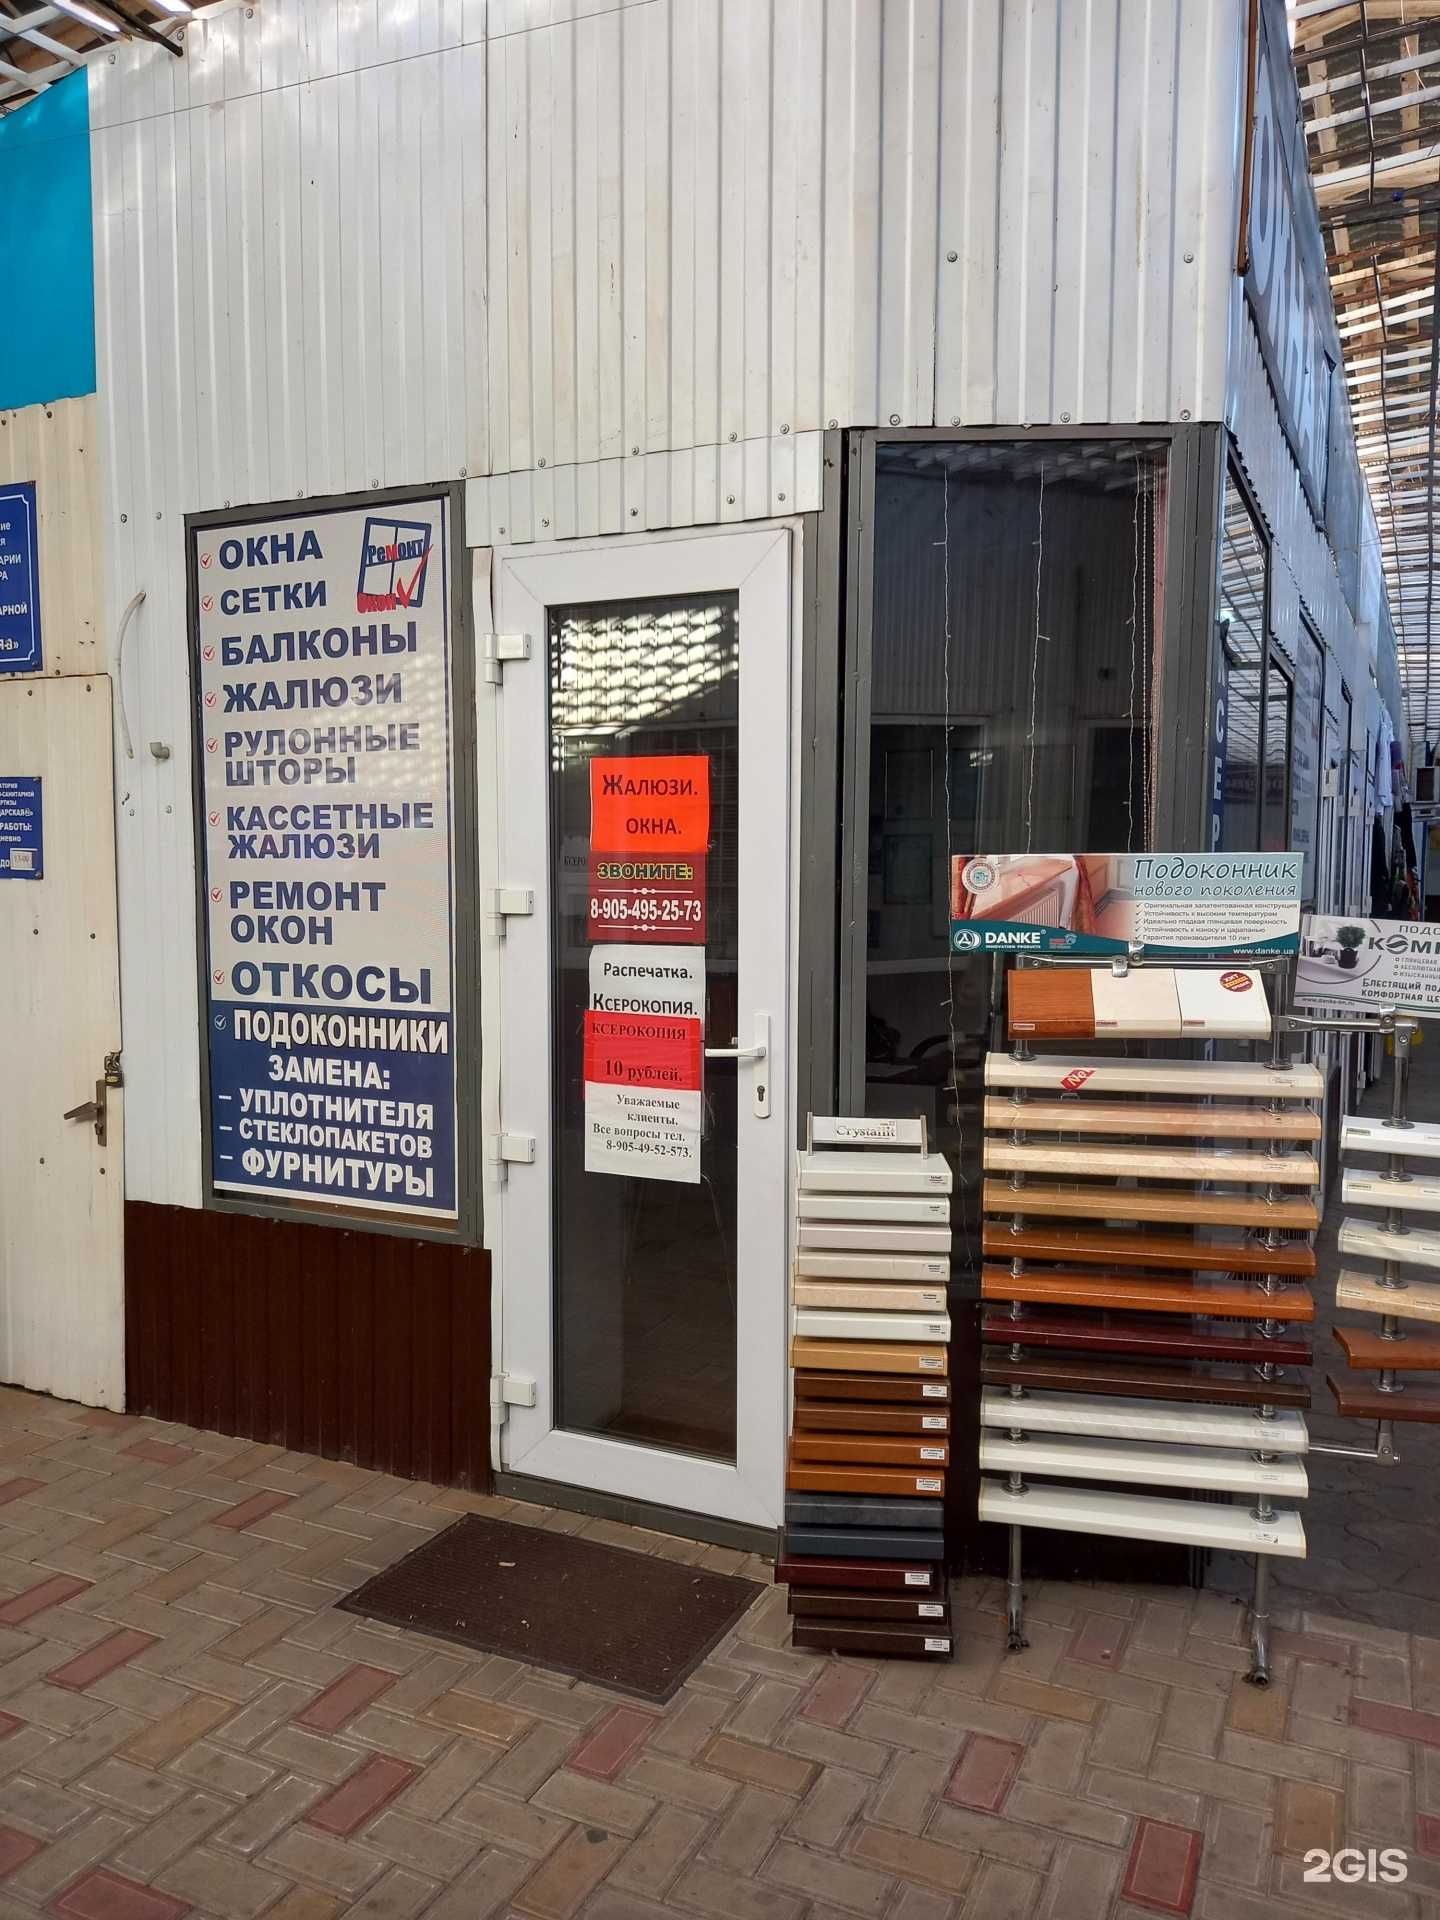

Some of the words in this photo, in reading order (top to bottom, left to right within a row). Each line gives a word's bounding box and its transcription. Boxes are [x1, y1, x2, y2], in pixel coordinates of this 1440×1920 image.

[219, 530, 323, 569] ОКНА
[220, 580, 327, 615] СЕТКИ
[221, 622, 417, 666] БАЛКОНЫ
[223, 673, 402, 713] ЖАЛЮЗИ
[225, 723, 420, 757] РУЛОННЫЕ
[225, 757, 356, 786] ШТОРЫ
[227, 803, 434, 830] КАССЕТНЫЕ
[228, 832, 380, 860] ЖАЛЮЗИ
[597, 862, 694, 880] ЗВОНИТЕ:
[1134, 856, 1297, 879] Подоконник
[229, 881, 386, 911] РЕМОНТ
[1134, 881, 1193, 896] нового
[1200, 884, 1296, 896] поколения
[590, 898, 701, 922] 8-905-495-25-73
[230, 914, 333, 945] ОКОН
[985, 932, 1040, 944] DANKE
[231, 961, 431, 1004] ОТКОСЫ
[603, 962, 693, 980] Распечатка.
[1362, 989, 1422, 1000] КОМФОРТНАЯ
[234, 1009, 448, 1054] ПОДОКОННИКИ
[592, 1022, 686, 1041] КСЕРОКОПИЯ
[268, 1055, 390, 1089] ЗАМЕНА:
[604, 1059, 623, 1076] 10
[627, 1065, 682, 1082] рублей.
[240, 1088, 433, 1130] УПЛОТНИТЕЛЯ
[616, 1094, 680, 1110] Уважаемые
[593, 1123, 611, 1135] Все
[614, 1127, 661, 1139] вопросы
[664, 1132, 685, 1142] тел.
[627, 1112, 678, 1126] клиенты.
[240, 1119, 432, 1158] СТЕКЛОПАКЕТОВ
[606, 1140, 692, 1158] 8-905-49-52-573.
[242, 1148, 433, 1197] ФУРНИТУРЫ
